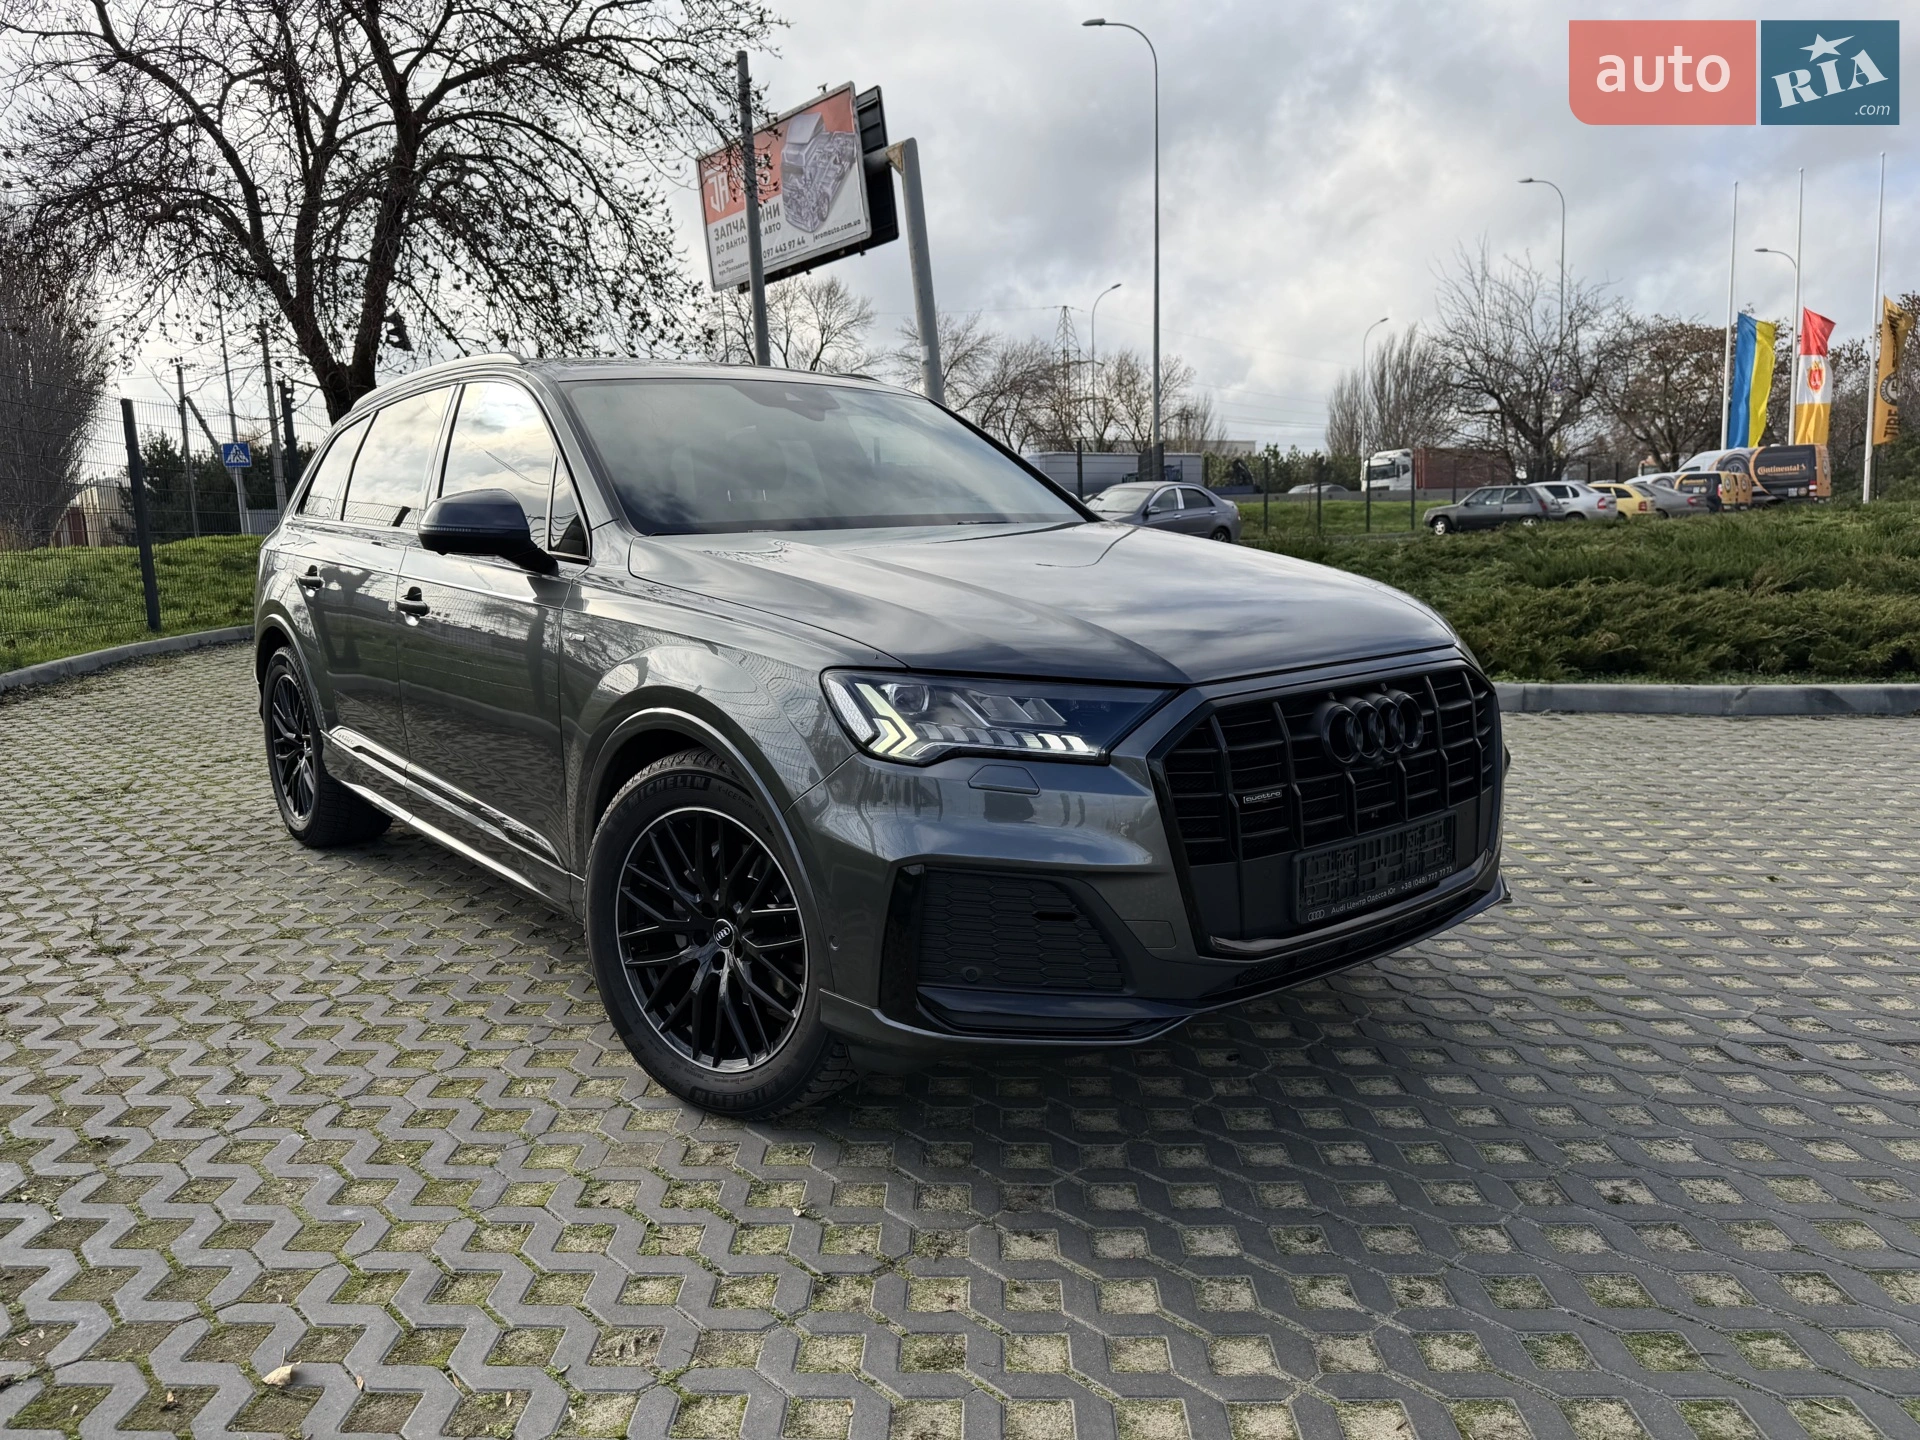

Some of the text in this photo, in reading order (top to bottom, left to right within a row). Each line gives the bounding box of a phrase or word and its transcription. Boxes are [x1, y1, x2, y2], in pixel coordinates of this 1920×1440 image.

[764, 222, 782, 237] АВТО
[774, 241, 787, 255] 443
[787, 239, 796, 251] 97
[796, 237, 806, 248] 44
[1757, 464, 1799, 476] Continental
[628, 775, 706, 808] MICHELIN
[1246, 791, 1281, 802] quattro
[1331, 903, 1347, 914] Audi
[1346, 898, 1366, 910] Центр
[1366, 890, 1387, 903] Одесса
[1387, 887, 1396, 896] Юг
